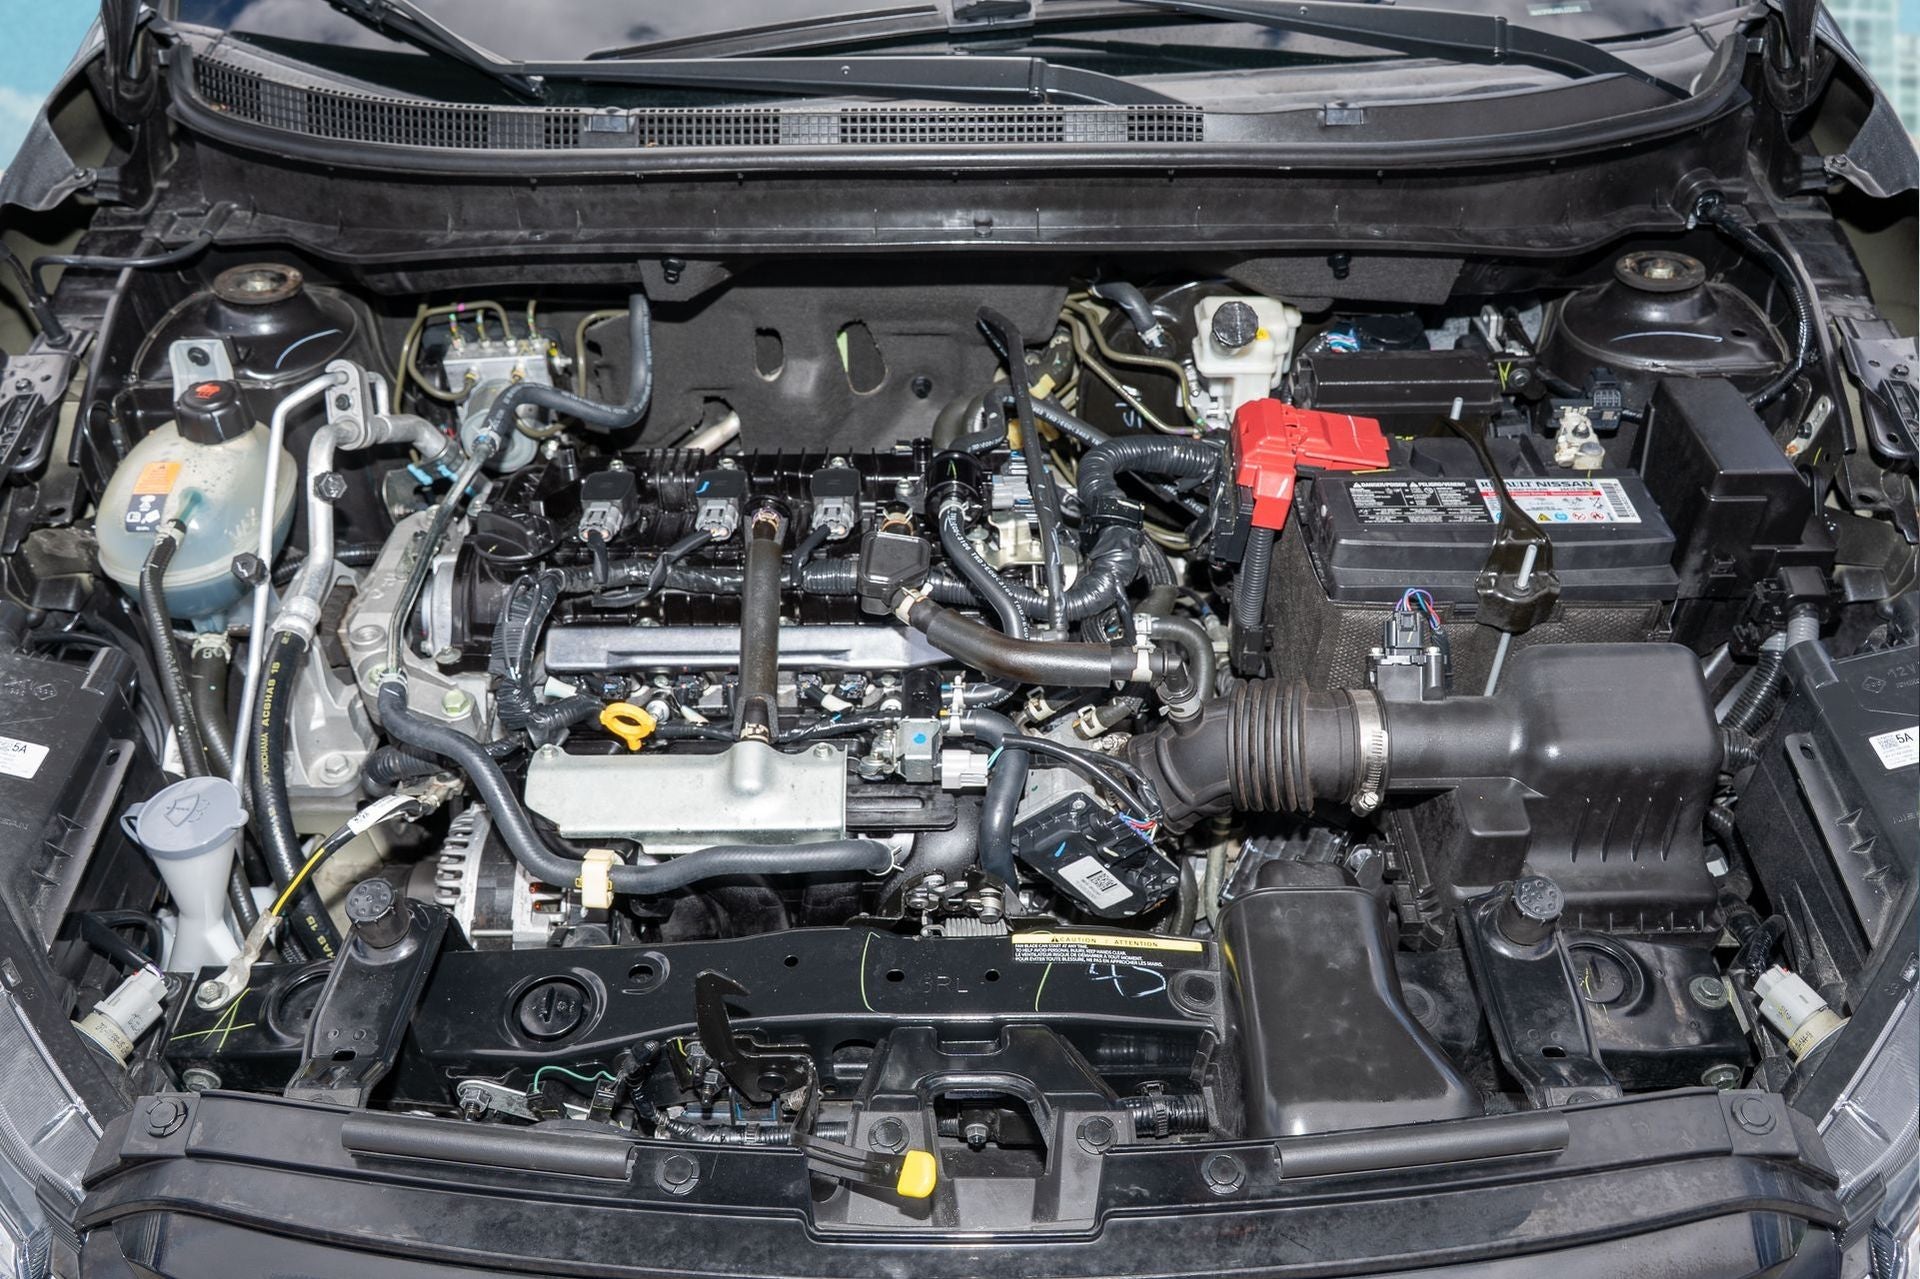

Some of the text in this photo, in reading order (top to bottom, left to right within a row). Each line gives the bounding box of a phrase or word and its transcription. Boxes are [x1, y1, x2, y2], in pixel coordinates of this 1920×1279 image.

[1895, 732, 1914, 744] 5A
[11, 742, 28, 755] 5A
[260, 731, 270, 777] YOKOHAMA
[1059, 936, 1159, 947] CAUTION ATTENTION
